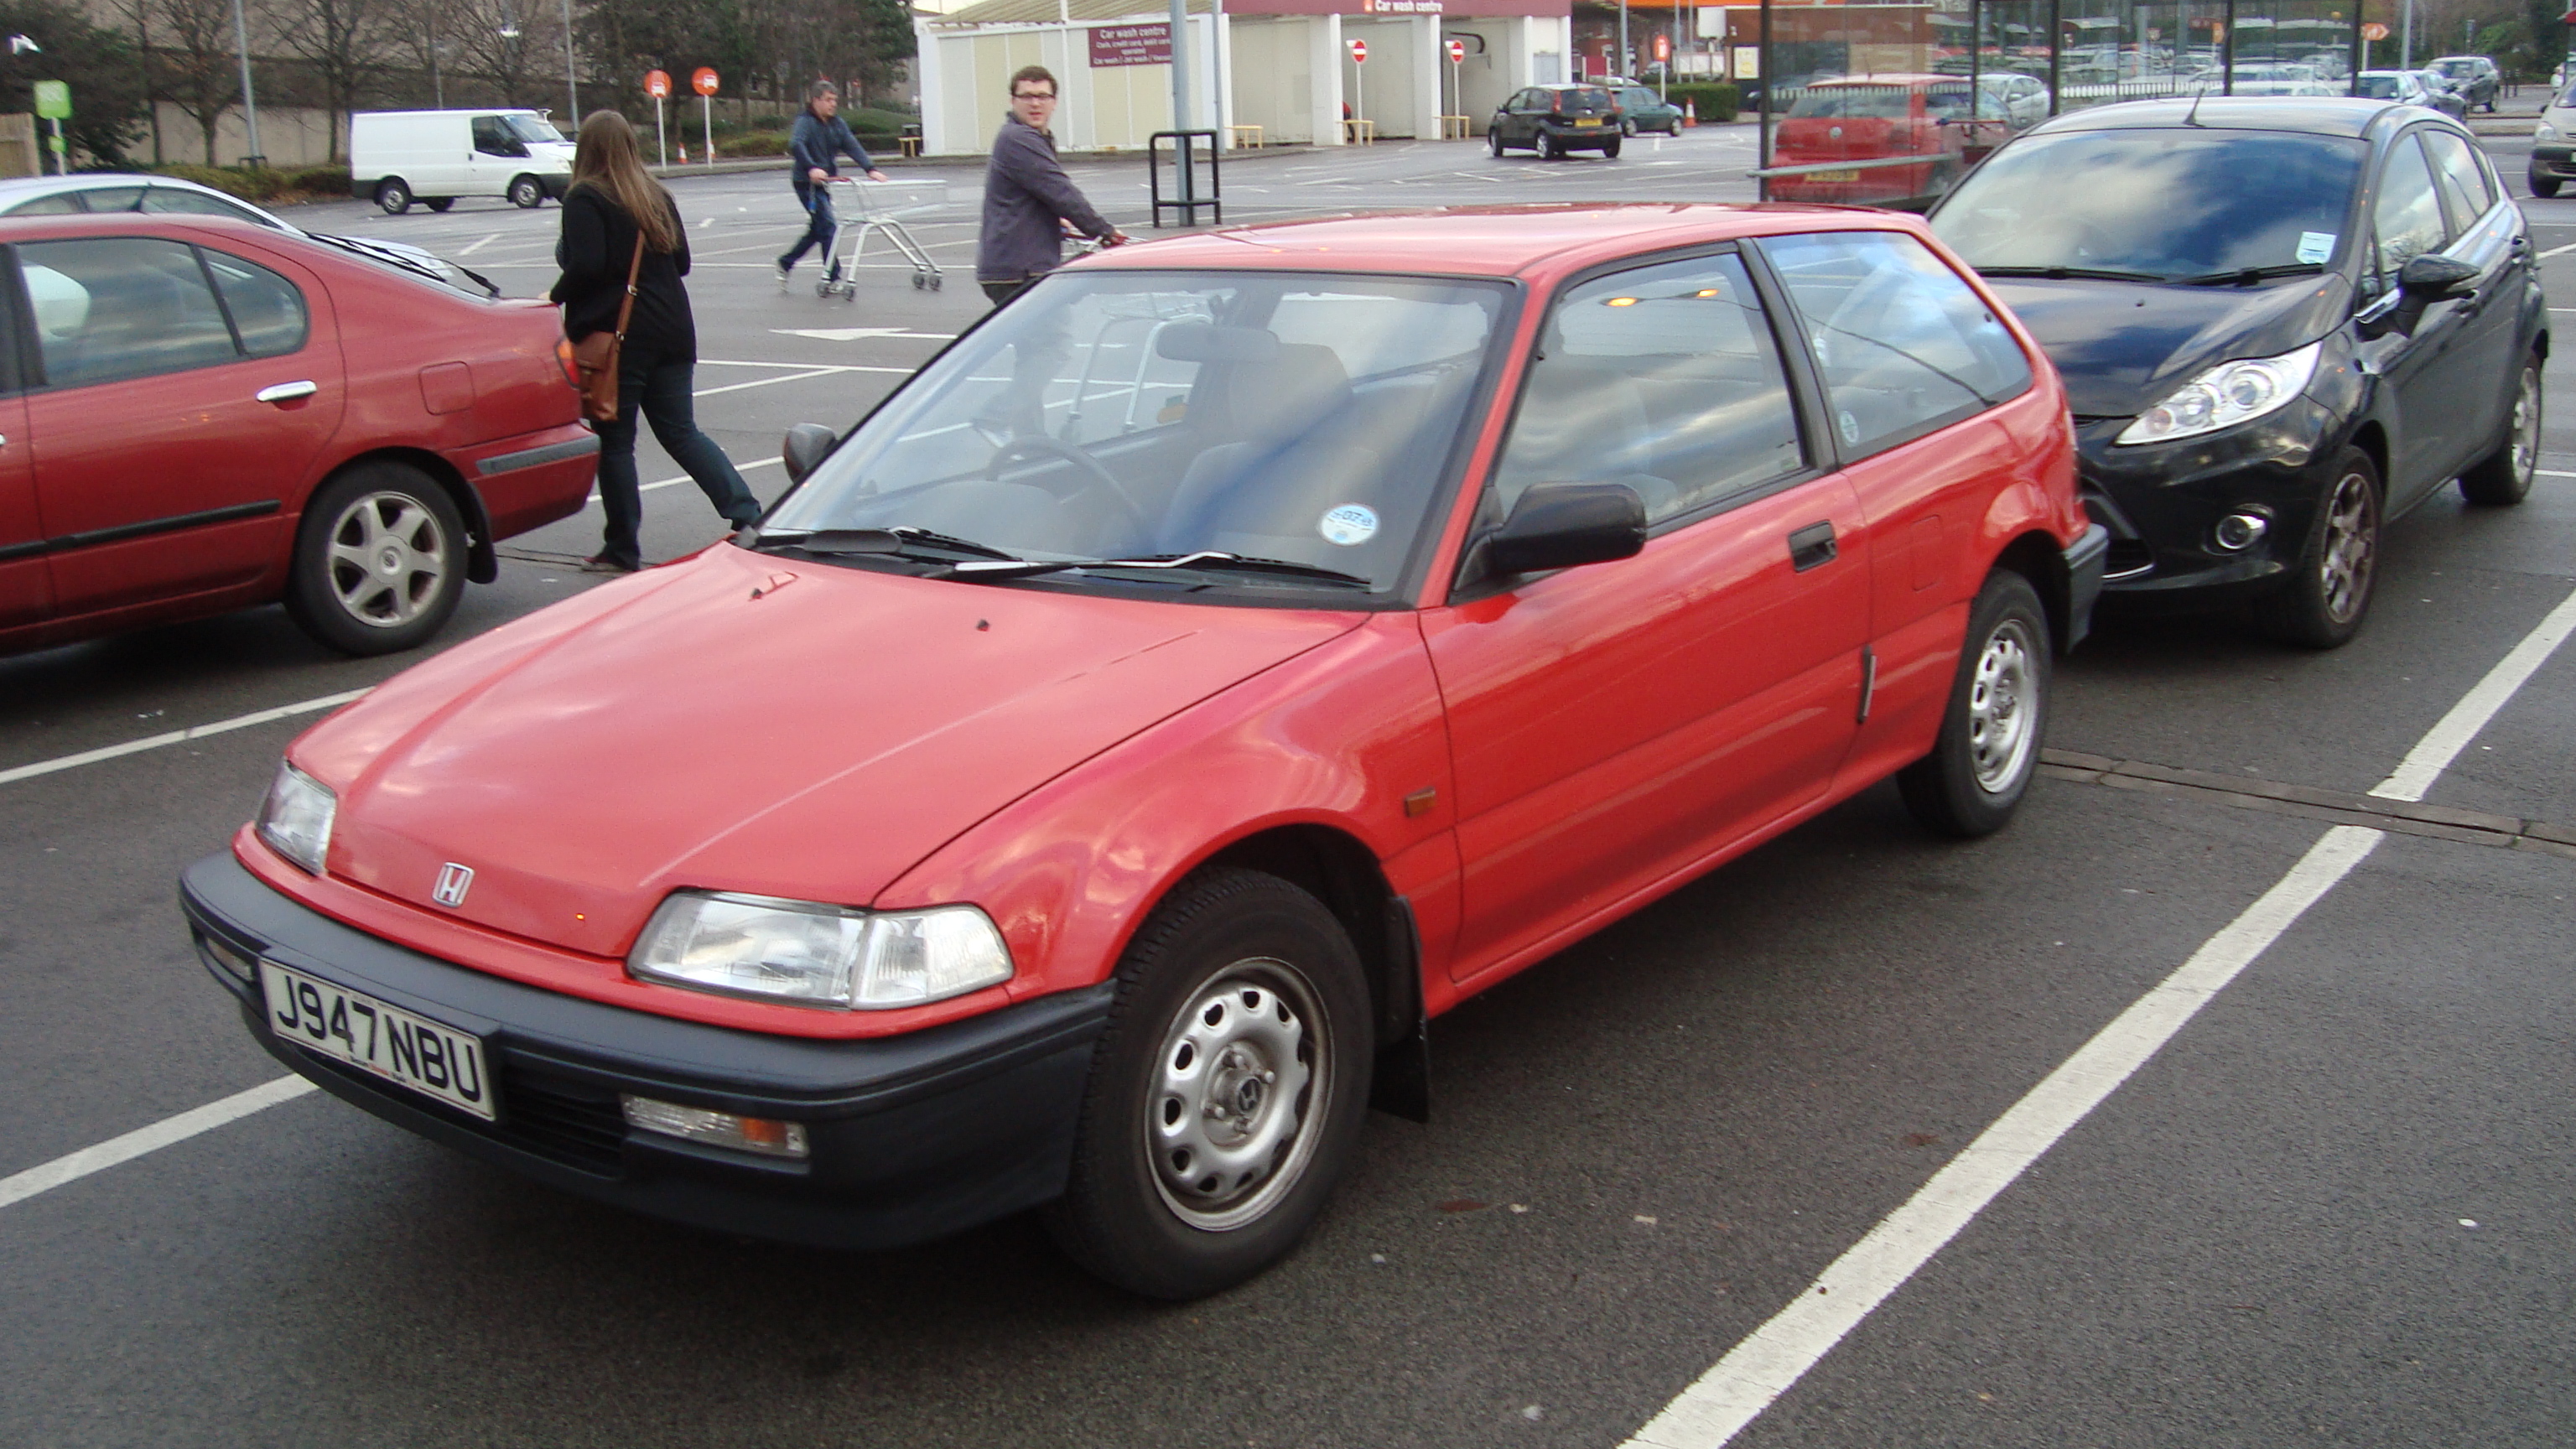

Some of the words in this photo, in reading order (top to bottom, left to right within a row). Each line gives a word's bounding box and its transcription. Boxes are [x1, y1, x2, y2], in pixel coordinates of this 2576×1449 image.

[1375, 0, 1391, 12] Car
[1393, 1, 1415, 12] wash
[1415, 1, 1443, 12] centre
[1099, 29, 1114, 39] Car
[1116, 28, 1138, 39] wash
[1139, 26, 1166, 36] centre
